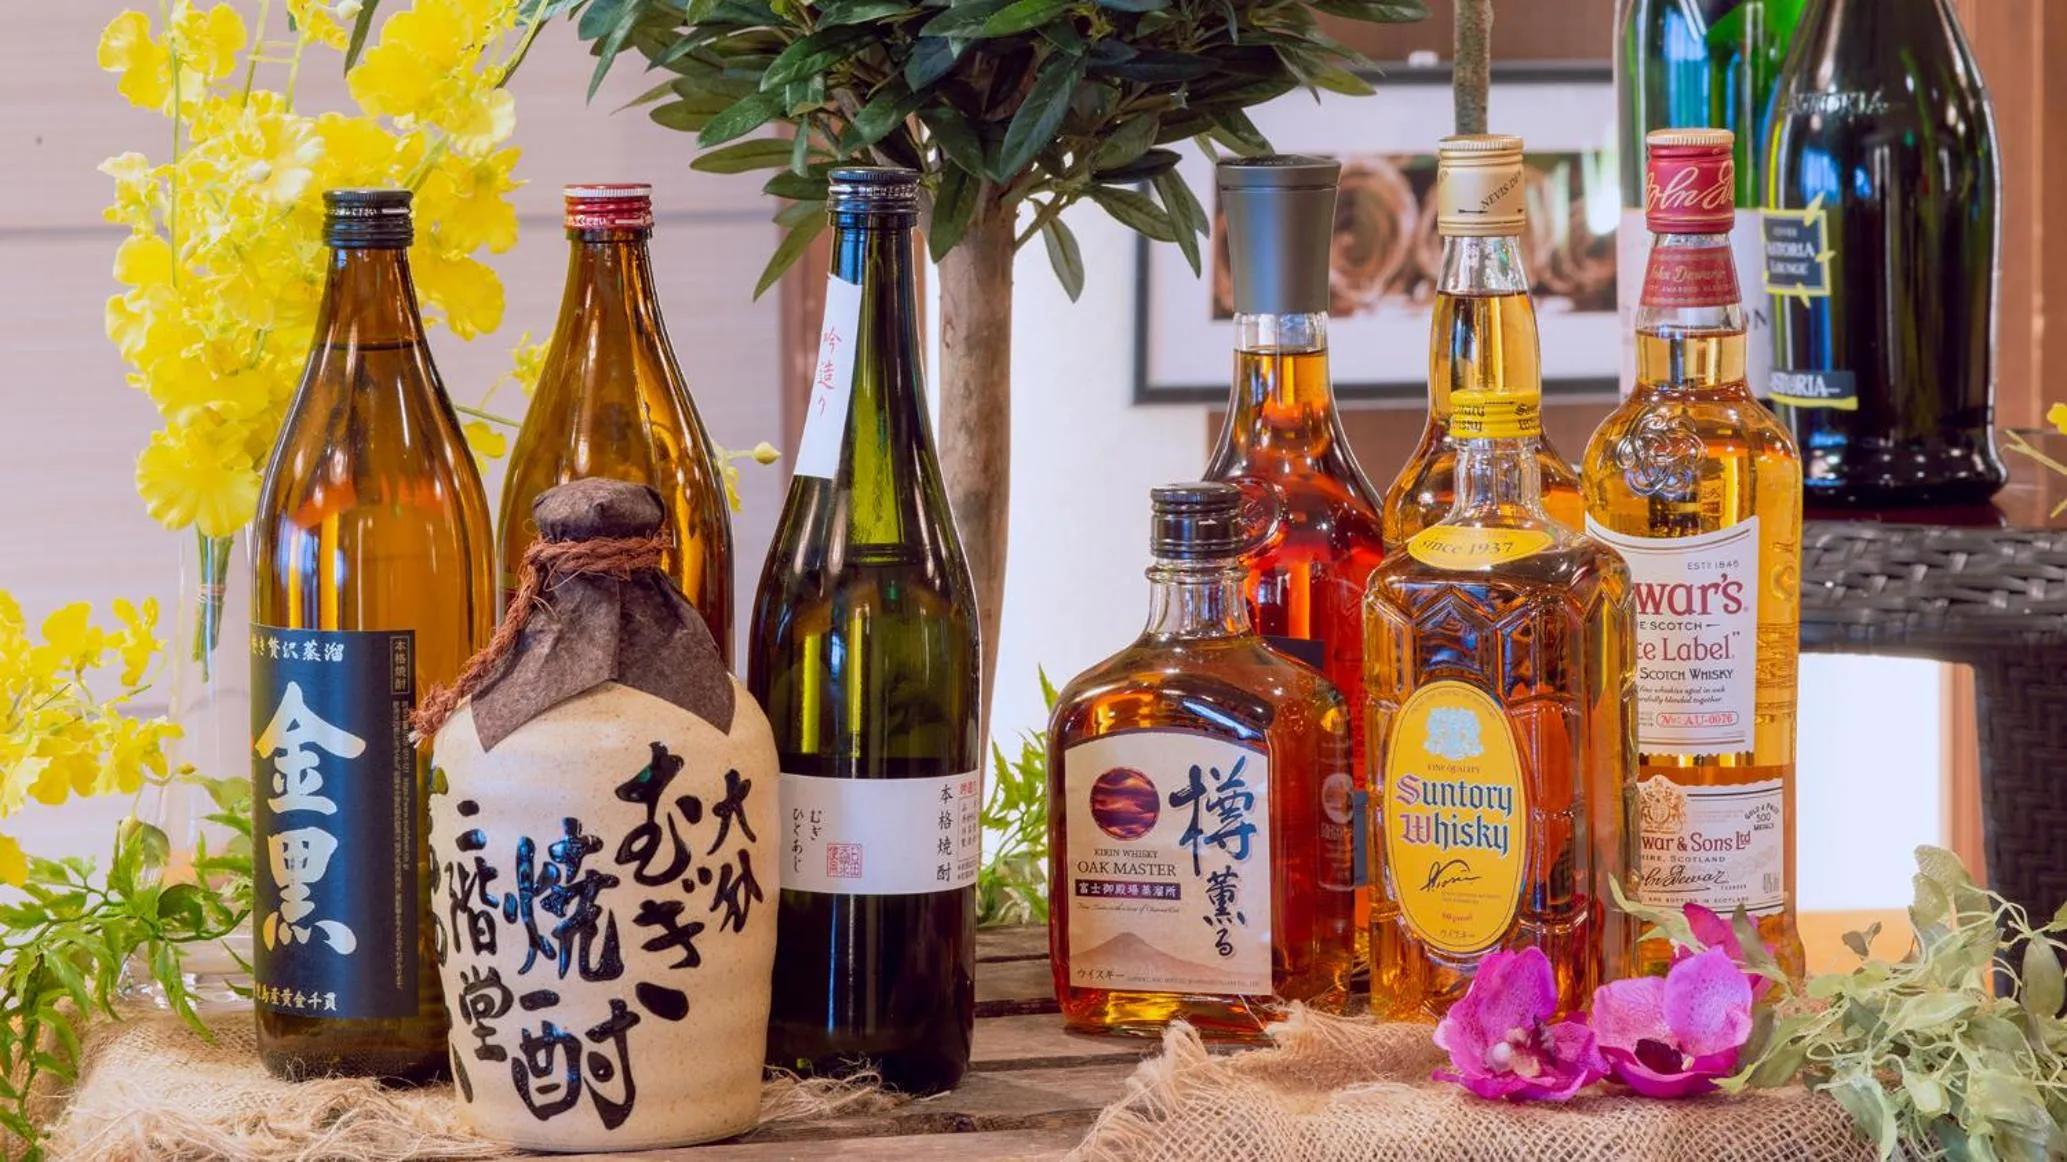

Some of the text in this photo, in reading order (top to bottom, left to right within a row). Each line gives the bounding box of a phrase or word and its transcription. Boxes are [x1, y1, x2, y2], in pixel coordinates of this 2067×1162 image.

[1421, 537, 1514, 555] since 1937
[1634, 573, 1744, 616] war's
[1650, 621, 1702, 631] SCOTCH
[1395, 773, 1513, 818] Suntory
[255, 681, 367, 956] 金黒
[936, 784, 954, 883] 本格焼酎
[1399, 811, 1509, 856] Whisky
[707, 768, 764, 933] 大分
[1093, 848, 1159, 859] KIRIN WHISKY
[1642, 830, 1751, 852] war & Sons Ltd
[1670, 855, 1727, 864] SCOTLAND
[1077, 860, 1177, 877] OAK MASTER
[444, 799, 515, 1063] 二階堂
[502, 816, 642, 1131] 焼酎
